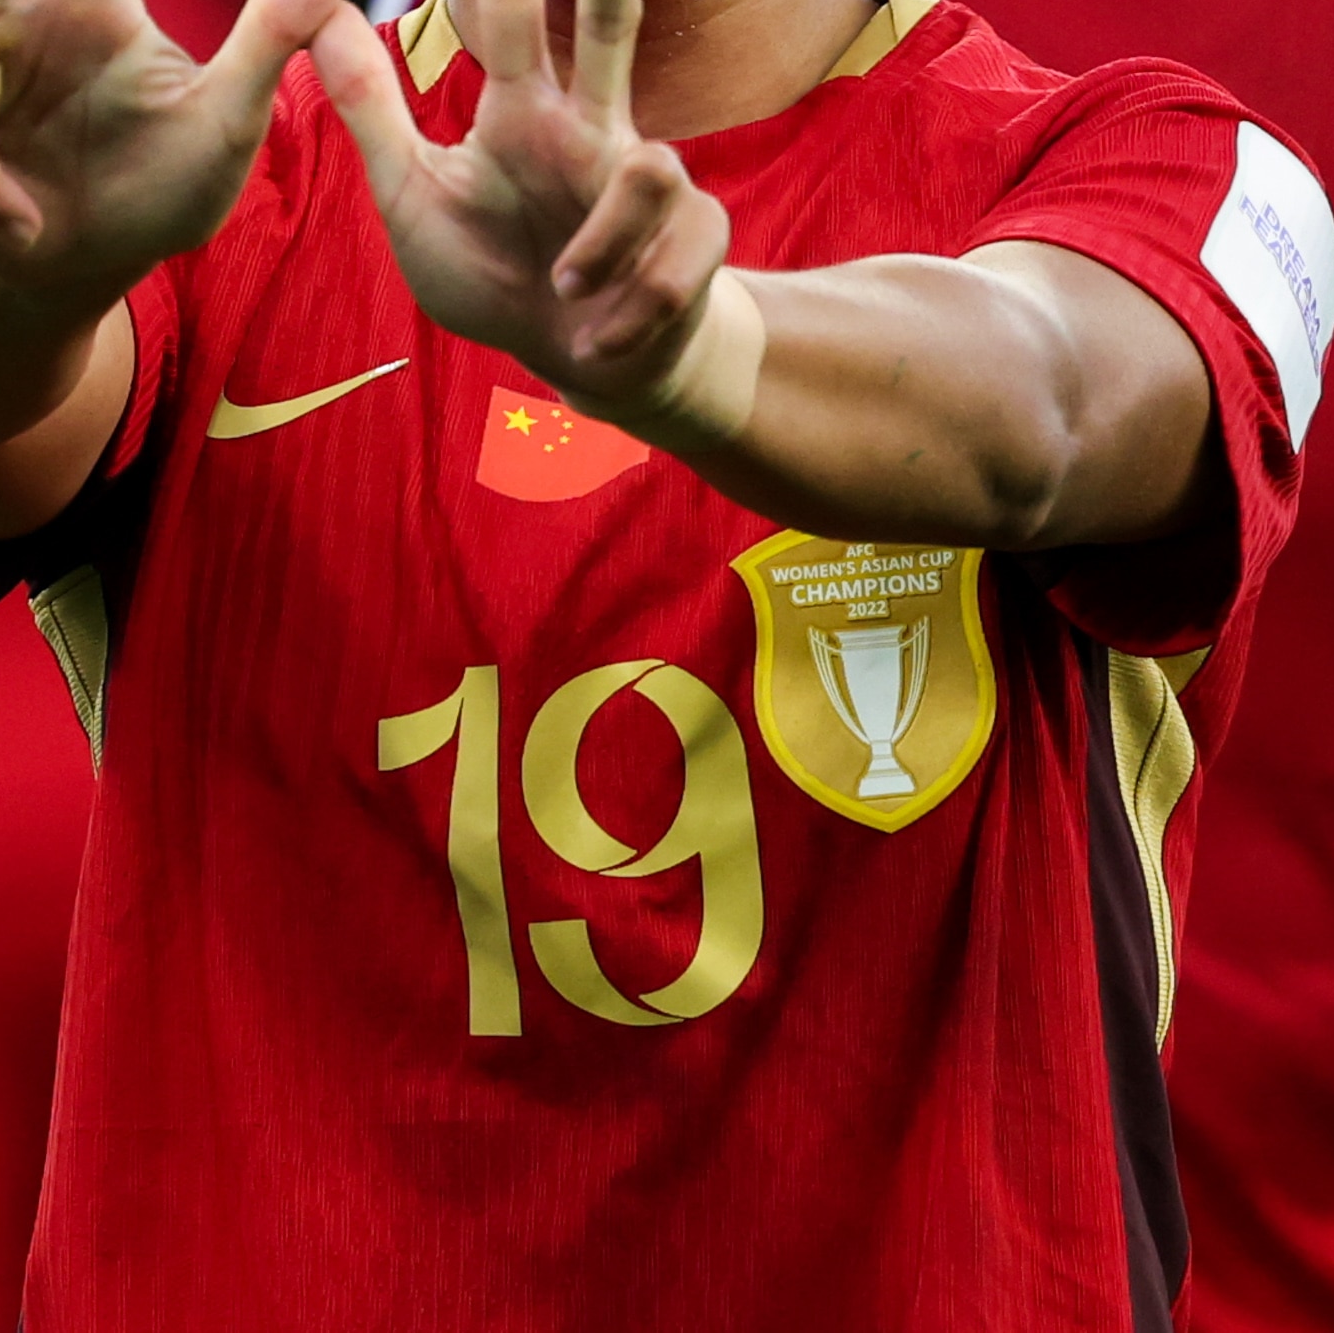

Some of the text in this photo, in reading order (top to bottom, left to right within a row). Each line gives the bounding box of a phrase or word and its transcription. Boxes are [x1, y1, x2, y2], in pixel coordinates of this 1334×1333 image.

[1261, 201, 1320, 336] DREAM
[771, 551, 953, 583] WOMEN'S ASIAN CUP
[846, 544, 874, 558] AFC
[791, 571, 939, 604] CHAMPIONS
[848, 601, 887, 617] 2022
[378, 658, 764, 1036] 19
